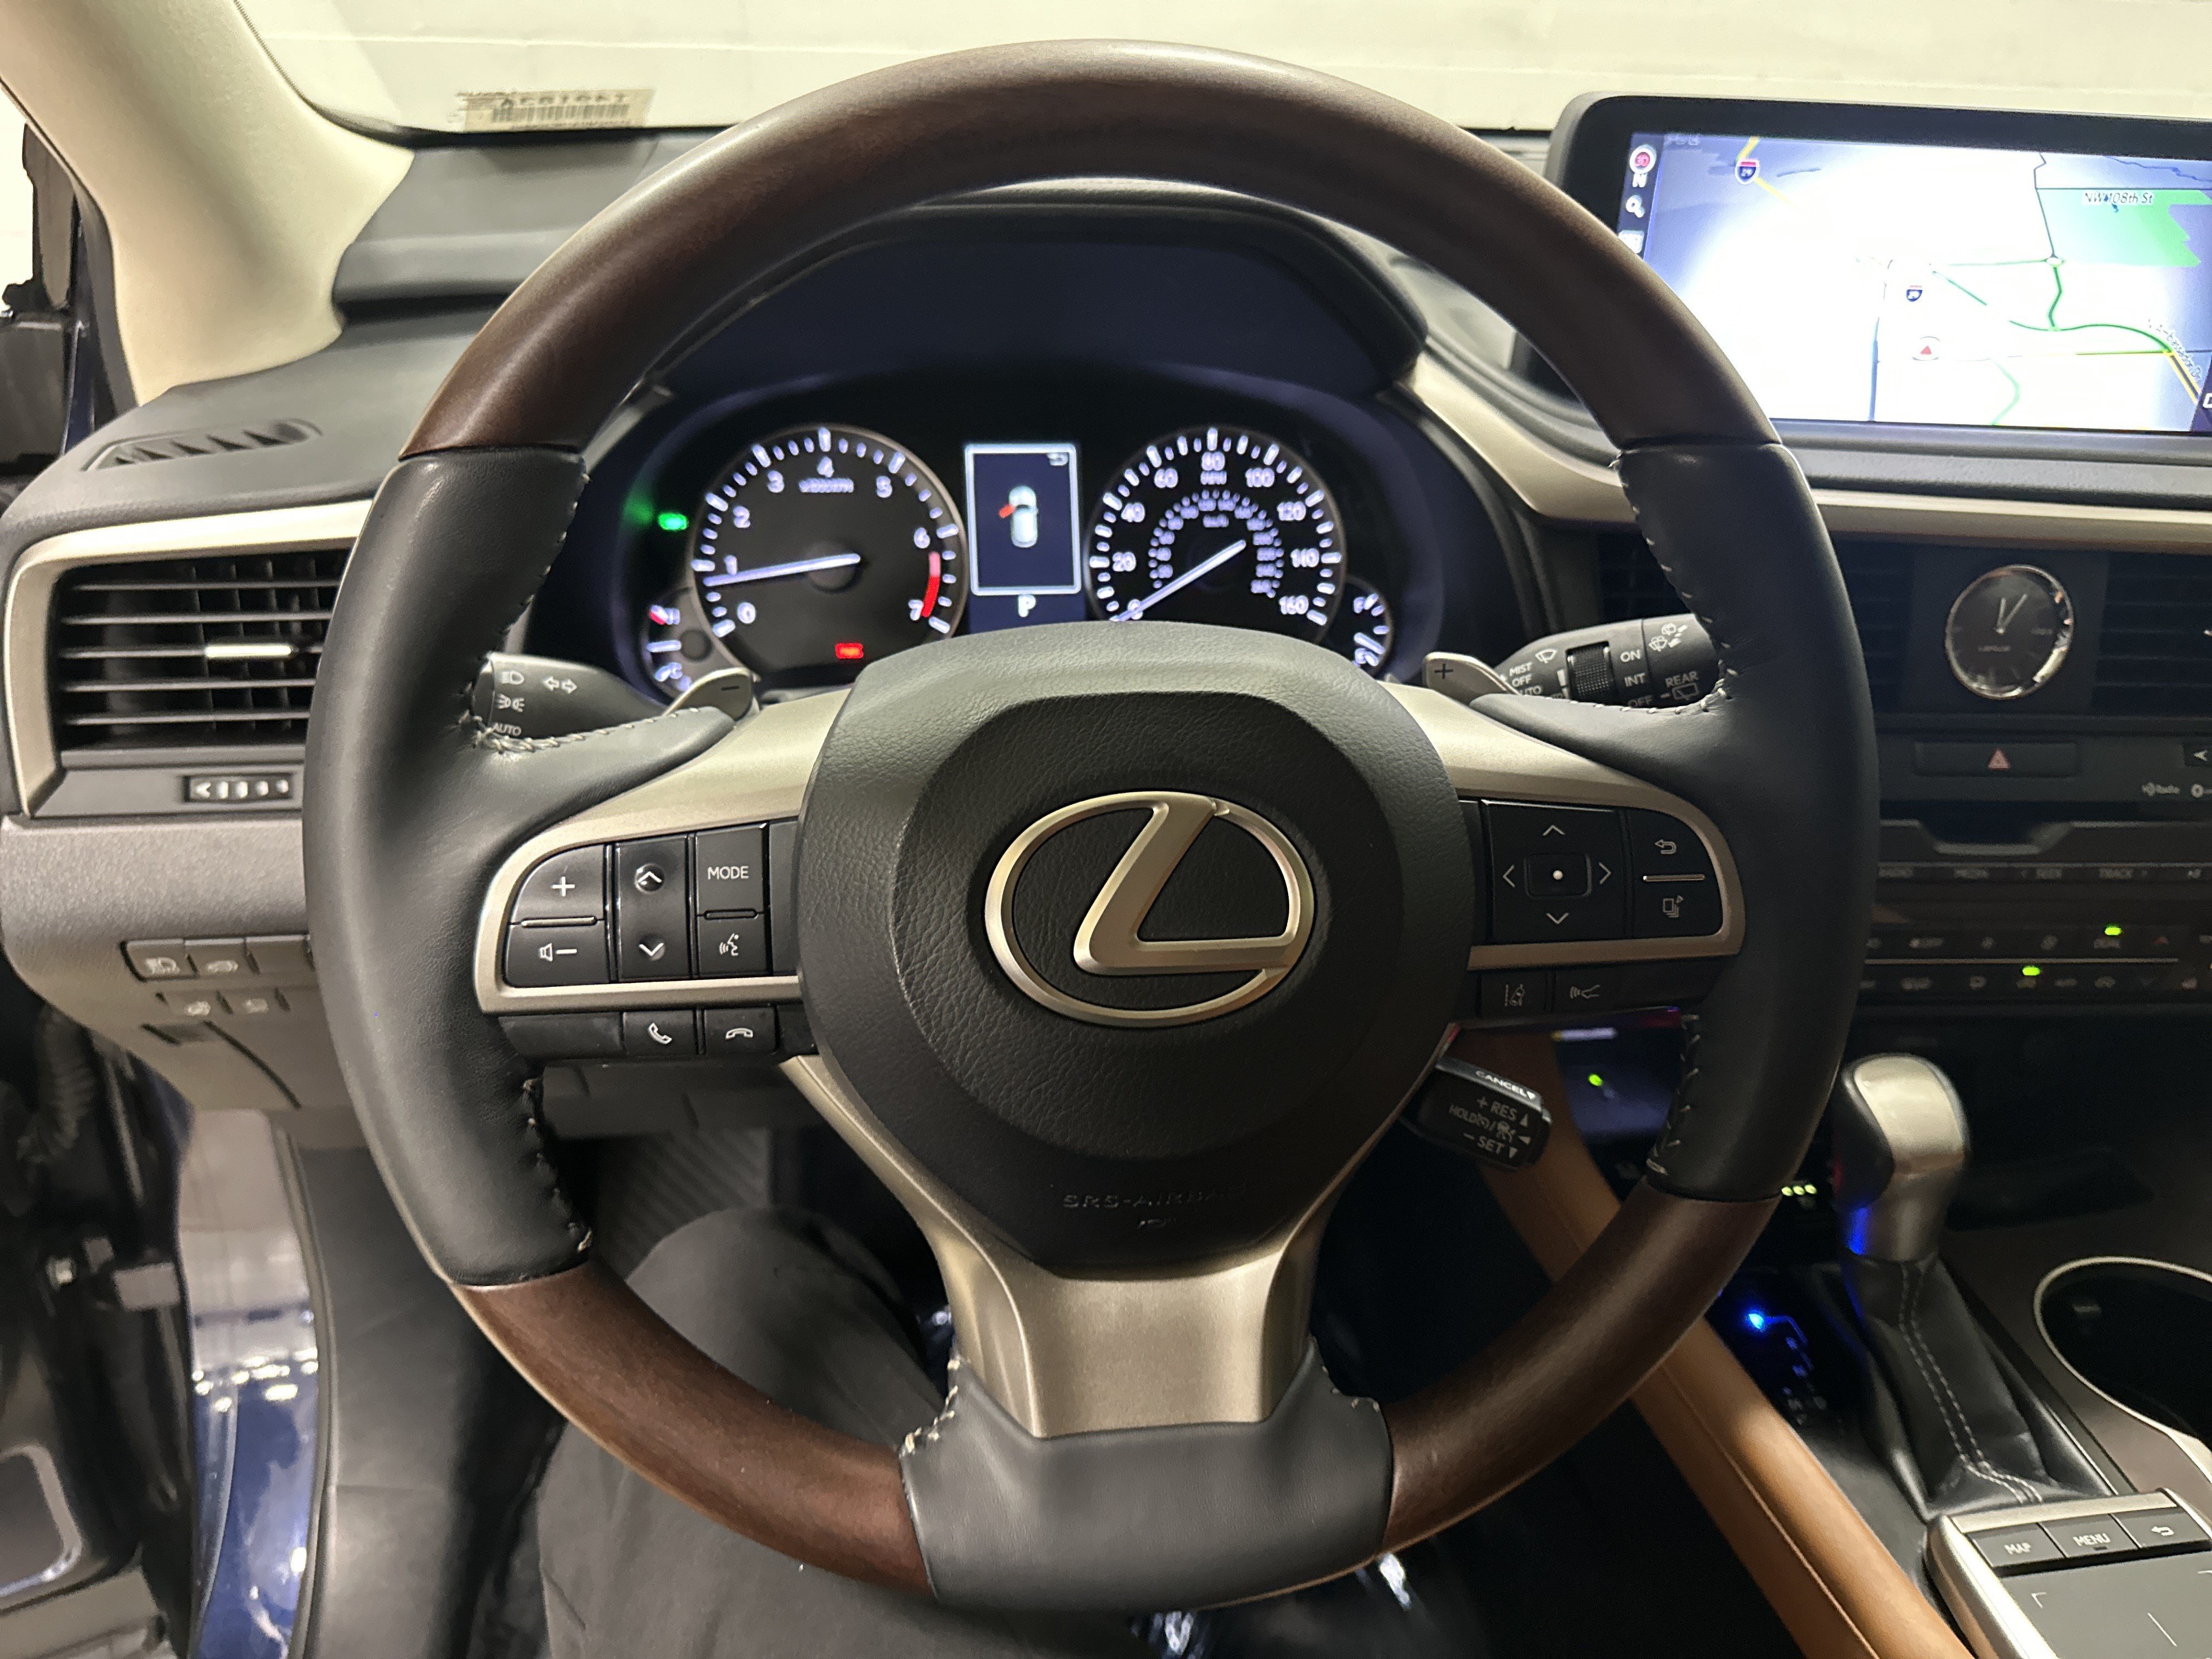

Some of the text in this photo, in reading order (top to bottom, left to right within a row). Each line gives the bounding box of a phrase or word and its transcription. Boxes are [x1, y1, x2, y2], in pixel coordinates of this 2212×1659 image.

[2141, 192, 2152, 204] St
[817, 455, 834, 478] 4
[1201, 451, 1226, 471] 80
[768, 470, 785, 493] 3
[876, 475, 893, 498] 5
[1154, 467, 1178, 488] 60
[1245, 467, 1275, 488] 100
[732, 505, 751, 528] 2
[1121, 501, 1146, 523] 40
[914, 527, 930, 549] 6
[725, 555, 737, 575] 1
[1112, 551, 1136, 572] 20
[737, 602, 756, 624] 0
[908, 599, 923, 621] 7
[1018, 594, 1036, 617] P
[1279, 595, 1309, 615] 160
[1620, 650, 1641, 662] ON
[1509, 661, 1533, 677] MIST
[1665, 671, 1699, 687] REAR
[1512, 674, 1532, 687] OFF
[1624, 672, 1645, 687] INT
[1520, 685, 1542, 695] UTO
[1628, 695, 1653, 708] OFF
[494, 723, 522, 736] AUTO
[708, 865, 749, 881] MODE
[1476, 1070, 1527, 1098] CANCEL
[1491, 1101, 1518, 1121] RES
[1477, 1135, 1505, 1155] SET
[2004, 1542, 2031, 1555] MAP
[2073, 1533, 2111, 1547] MENU
